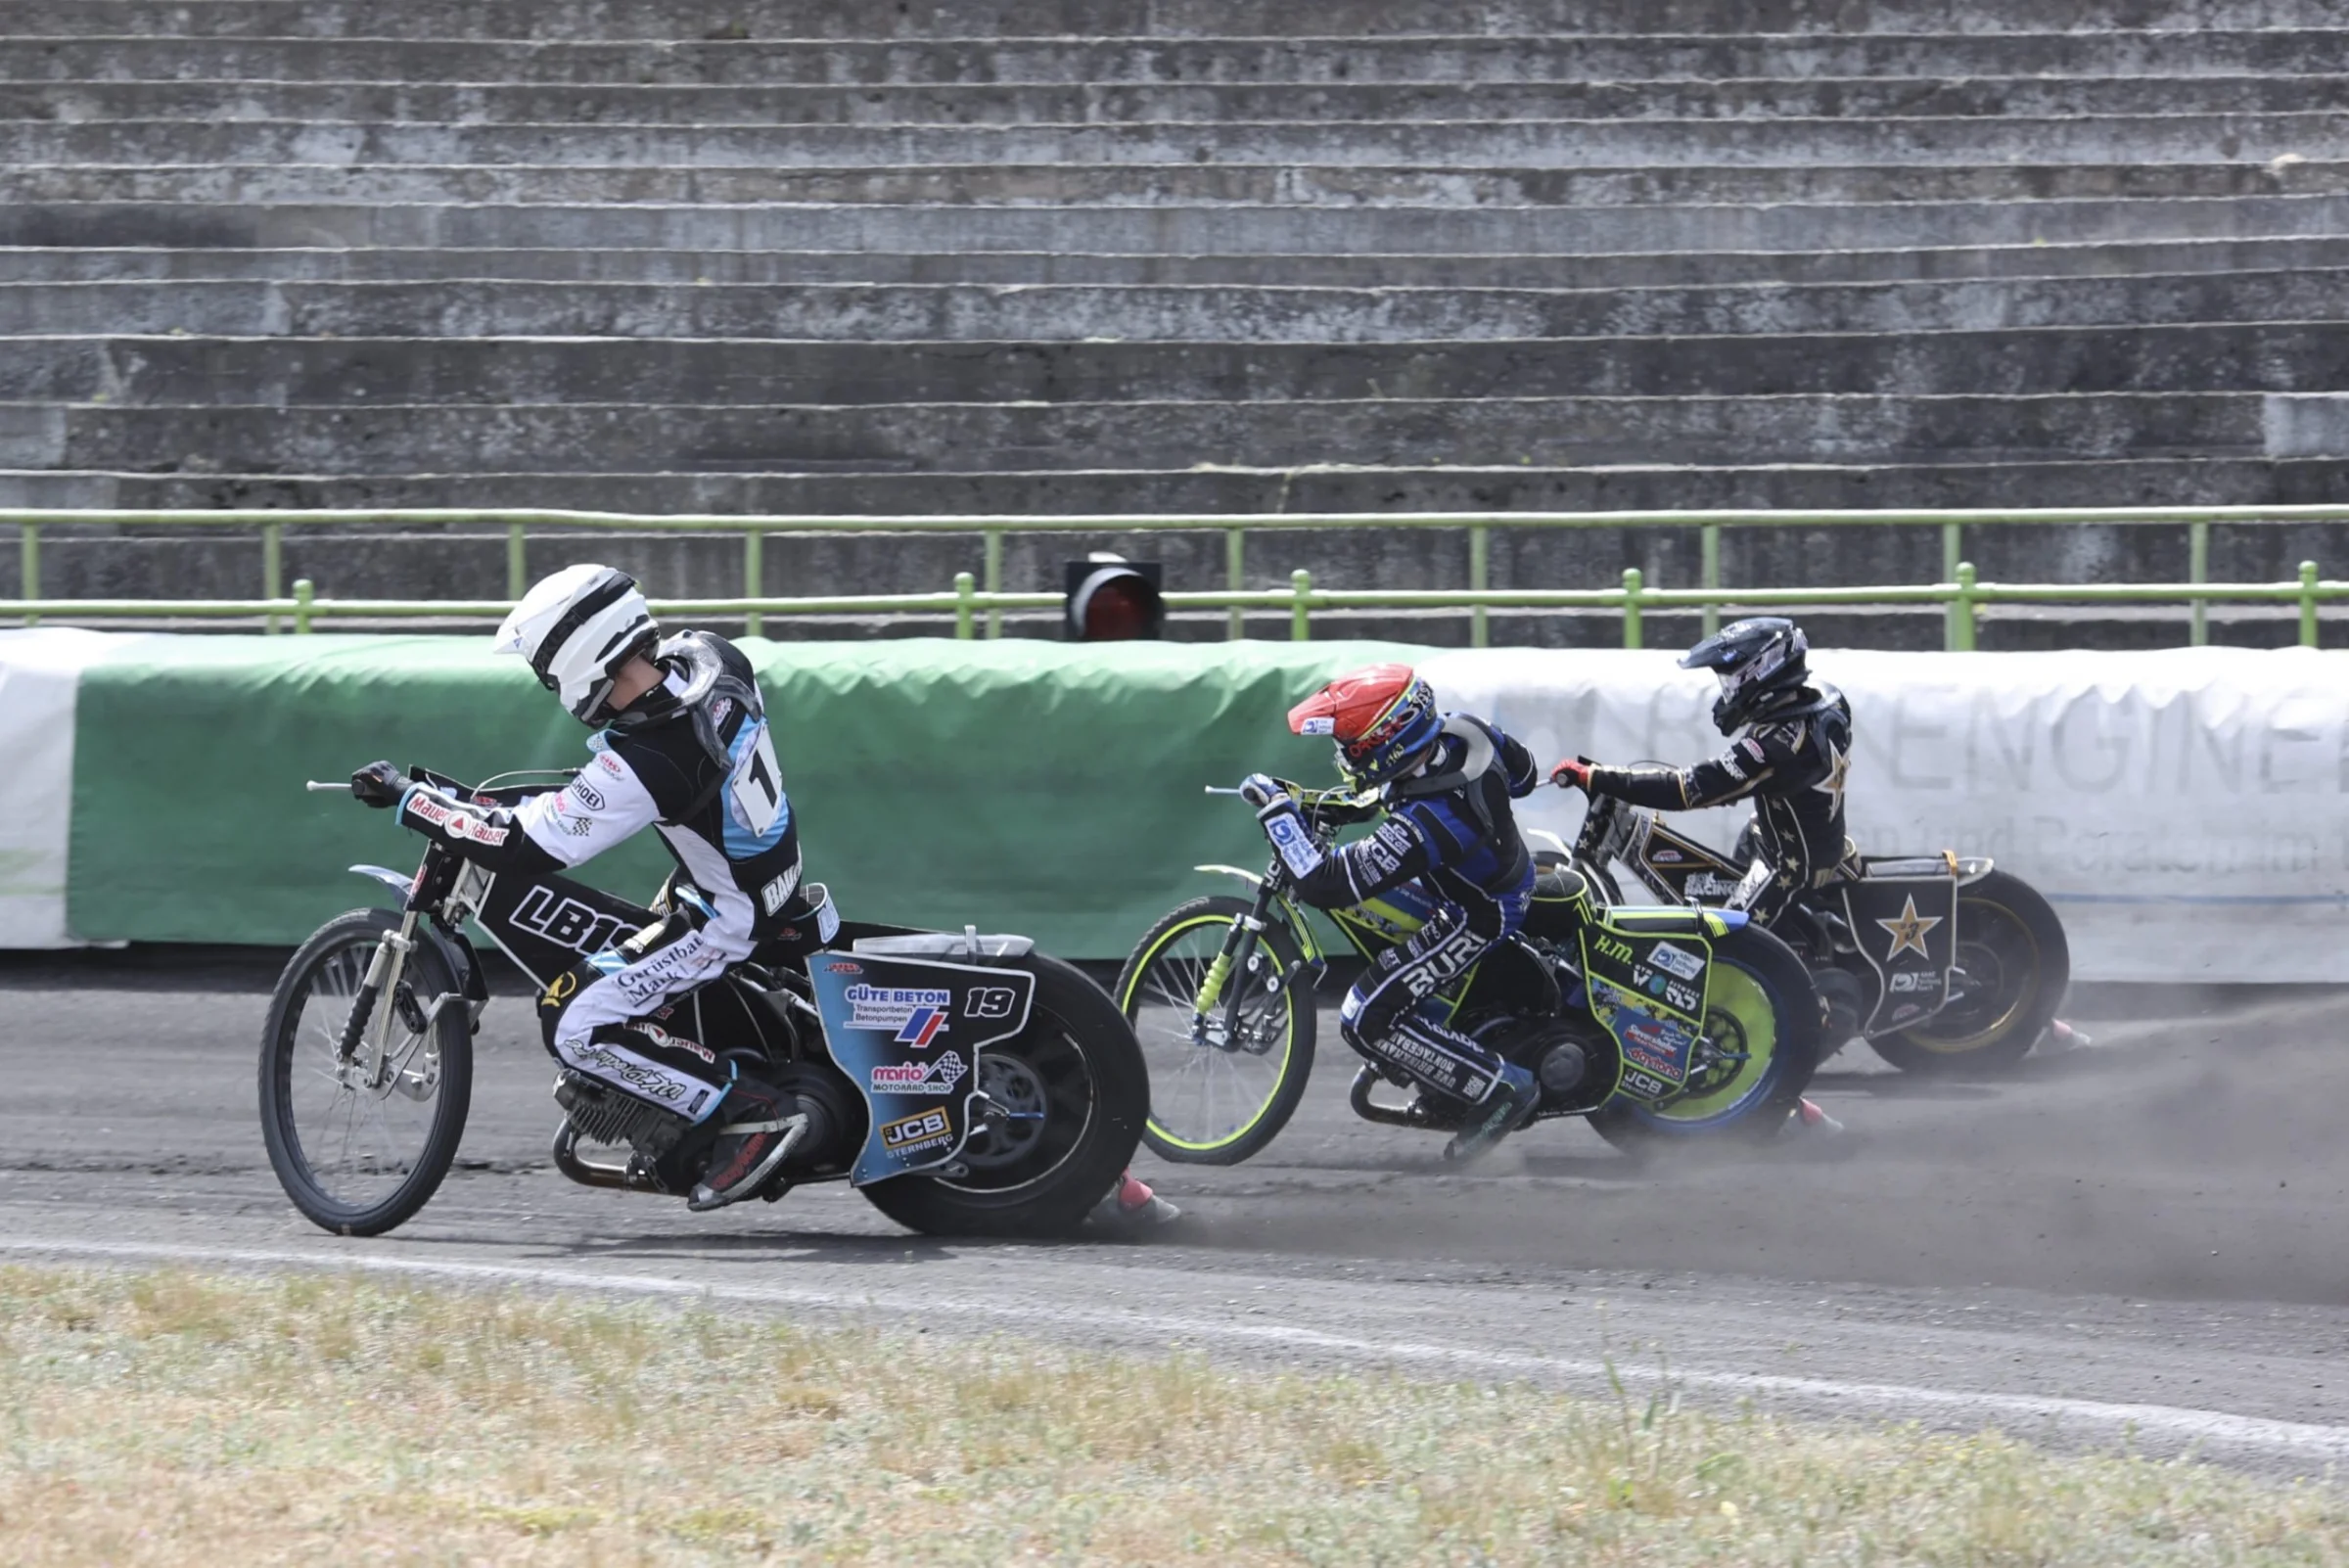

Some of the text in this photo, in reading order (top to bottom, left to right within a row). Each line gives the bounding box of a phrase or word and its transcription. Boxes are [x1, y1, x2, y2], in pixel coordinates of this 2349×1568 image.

[1892, 681, 2349, 793] ENGINE
[573, 777, 600, 807] SHOEI
[749, 749, 777, 809] 1
[411, 795, 449, 822] Mauer
[468, 820, 506, 844] Häuser
[847, 985, 948, 1004] GÜTE BETON
[964, 987, 1016, 1018] 19
[855, 1003, 913, 1015] Transportbeton
[855, 1013, 908, 1024] Betonpumpen
[1390, 1032, 1456, 1074] MONTAGEBAU
[873, 1061, 924, 1082] mario
[1625, 1070, 1662, 1094] JCB
[873, 1083, 952, 1093] MOTORRAD SHOP
[888, 1114, 945, 1144] JCB
[887, 1133, 953, 1159] STERNBERG
